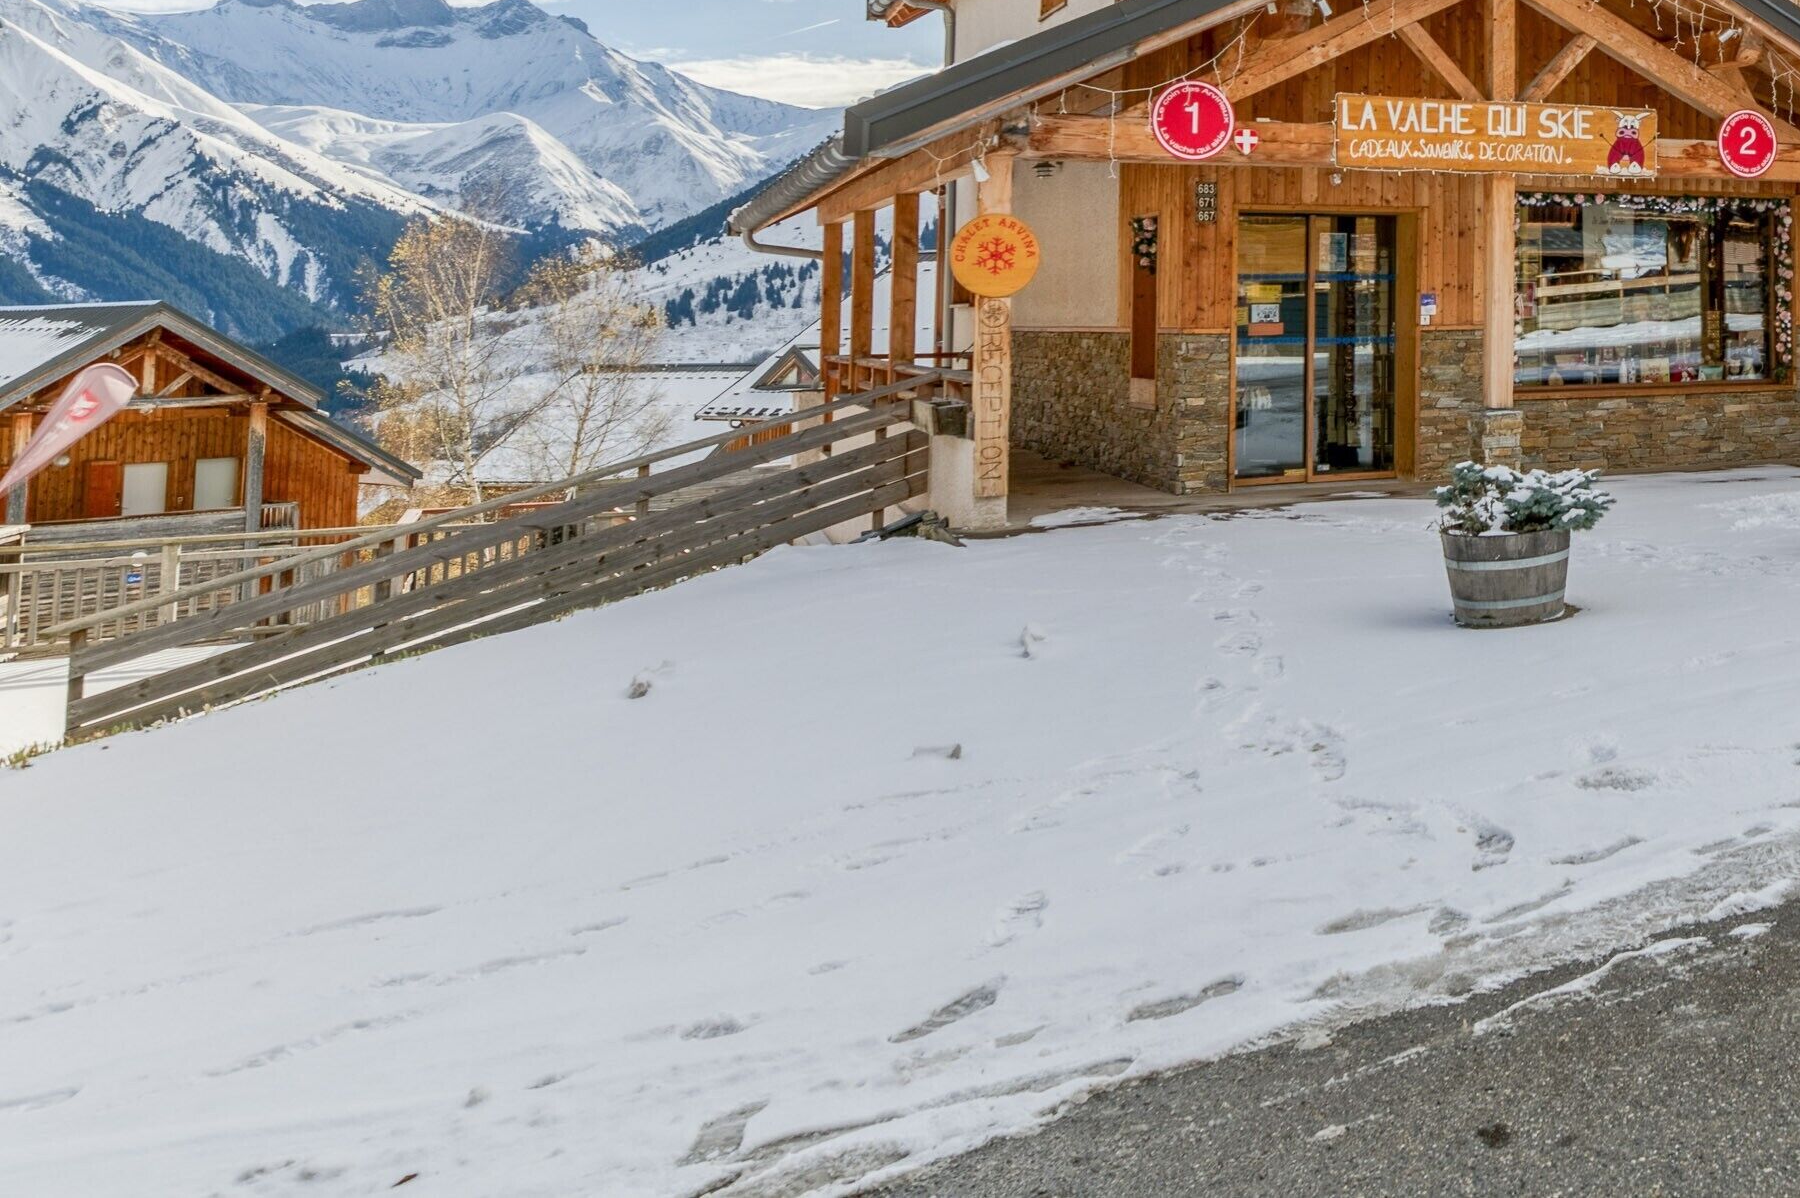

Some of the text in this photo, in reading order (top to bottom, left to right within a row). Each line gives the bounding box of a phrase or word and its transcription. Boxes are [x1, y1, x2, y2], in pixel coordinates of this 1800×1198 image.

[1157, 106, 1166, 121] Le
[1163, 88, 1181, 106] coin
[1181, 86, 1200, 94] des
[1184, 101, 1199, 134] 1
[1342, 99, 1594, 139] LA VACHE QUI SKIE
[1160, 127, 1227, 155] La vache qui skie
[1740, 126, 1757, 155] 2
[1198, 183, 1215, 194] 683
[1198, 197, 1215, 208] 671
[1198, 211, 1215, 221] 667
[955, 218, 1036, 262] CHALET ARVINA
